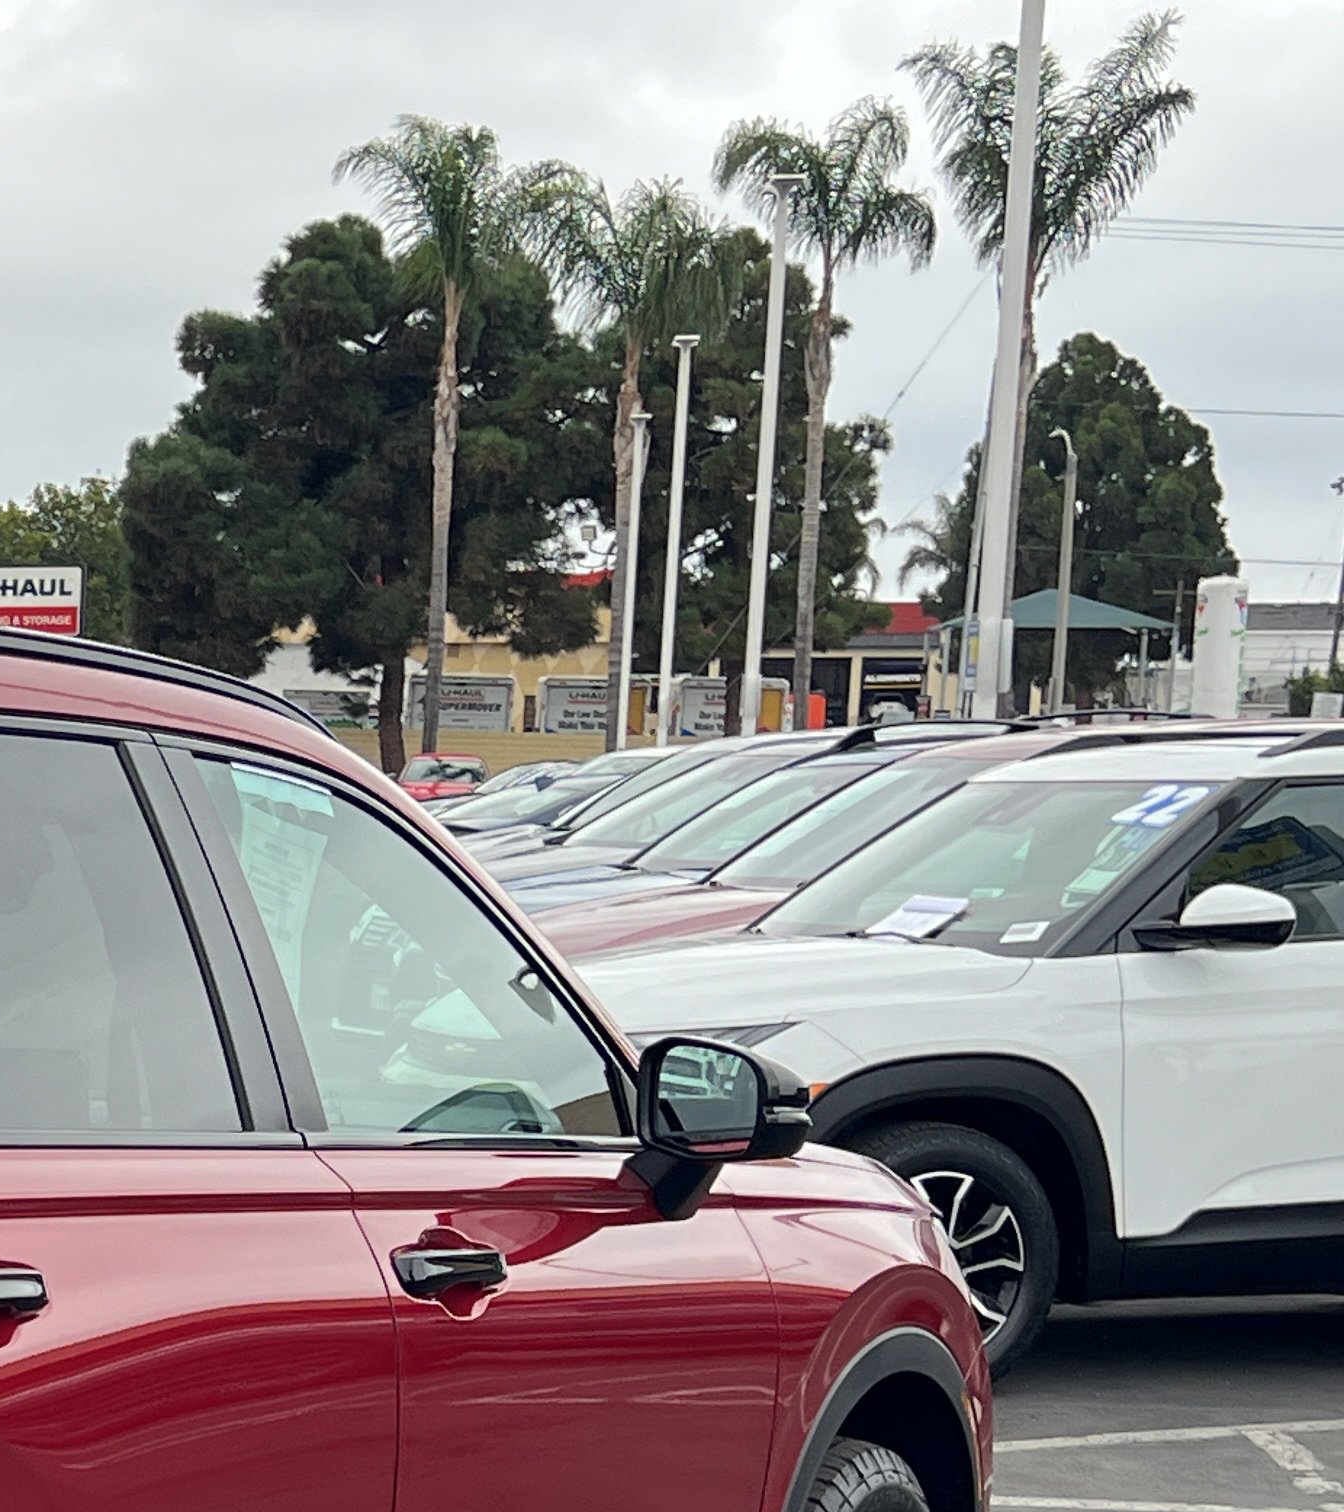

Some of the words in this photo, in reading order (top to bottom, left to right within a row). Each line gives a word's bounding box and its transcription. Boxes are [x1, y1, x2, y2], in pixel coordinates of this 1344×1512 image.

[23, 615, 73, 626] STORAGE
[568, 692, 608, 700] U-HAU
[1110, 783, 1210, 828] 22
